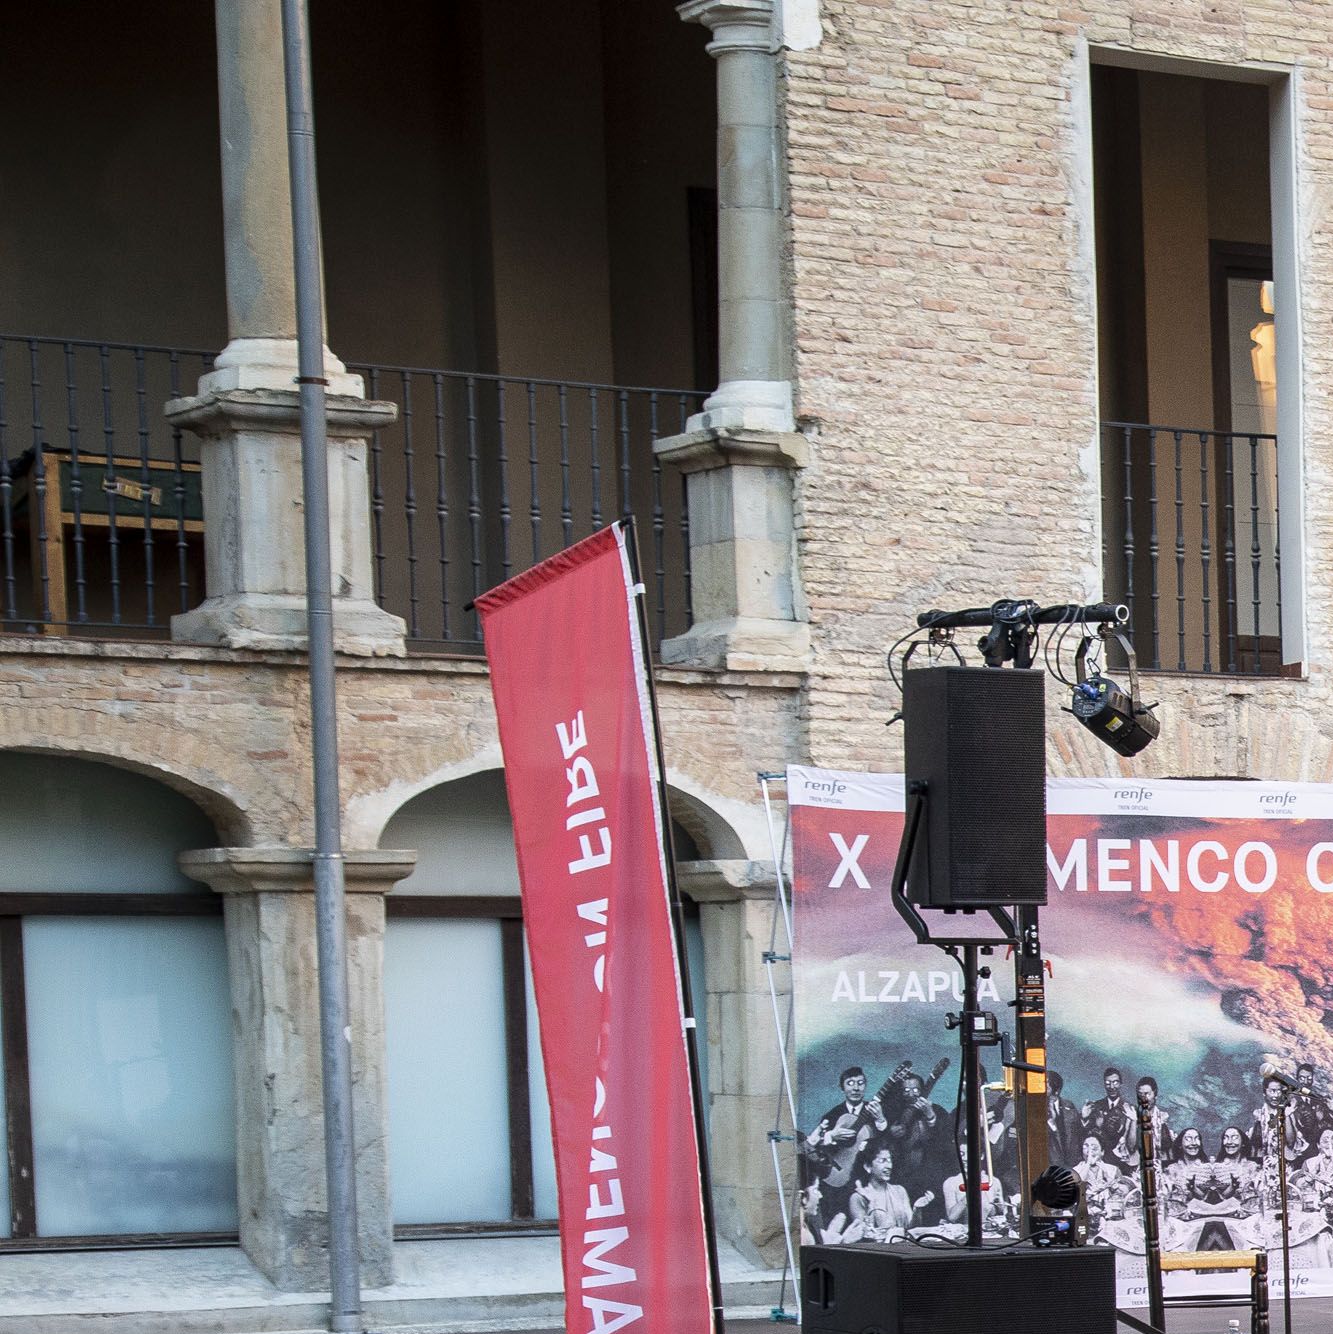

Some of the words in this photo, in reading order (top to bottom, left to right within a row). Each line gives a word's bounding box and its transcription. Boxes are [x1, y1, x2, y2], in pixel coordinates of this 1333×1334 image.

[804, 779, 848, 796] renfe
[1113, 787, 1153, 804] renfe
[1259, 791, 1297, 807] renfe
[828, 832, 872, 890] X
[1044, 838, 1278, 894] MENCO
